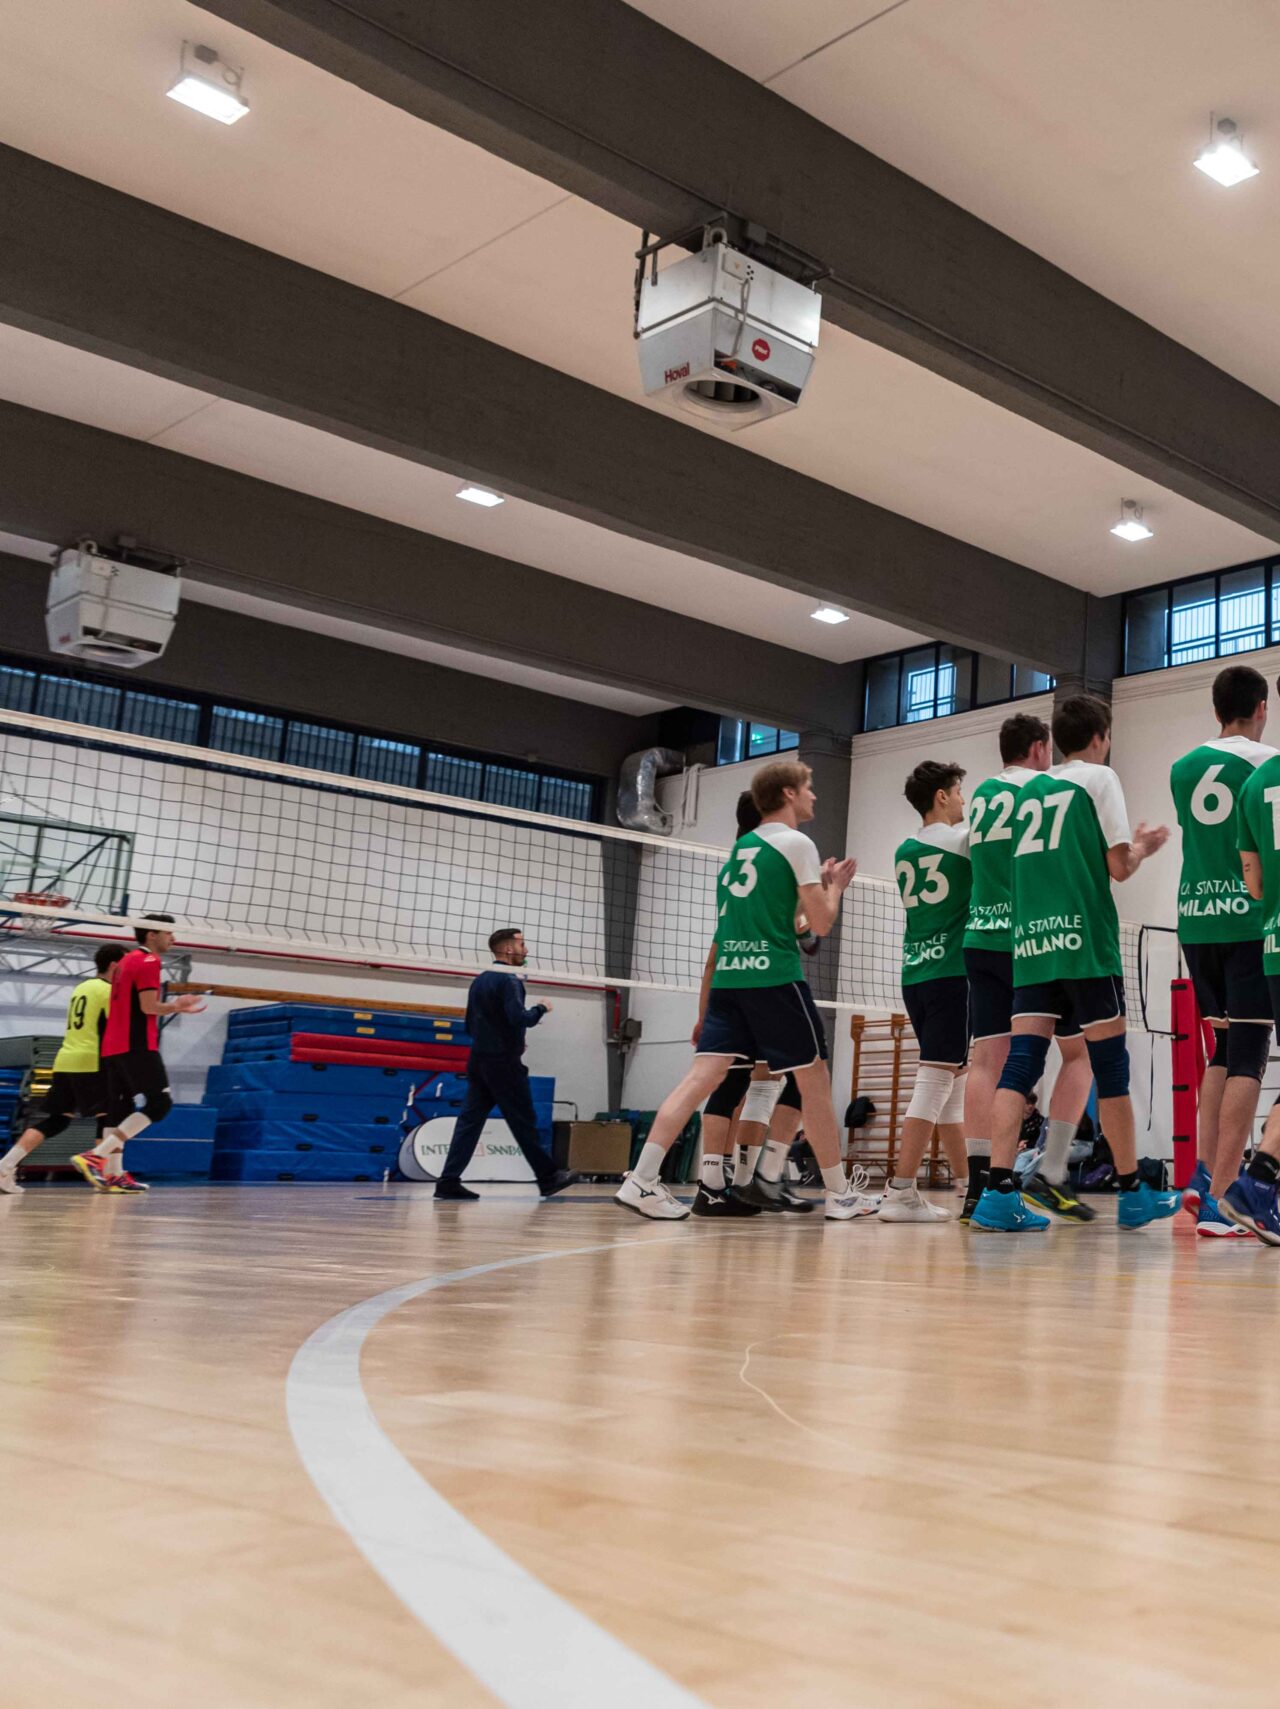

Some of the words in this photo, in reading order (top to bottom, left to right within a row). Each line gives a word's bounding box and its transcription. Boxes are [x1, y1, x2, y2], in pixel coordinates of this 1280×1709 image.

[664, 362, 690, 384] Hoval
[1190, 764, 1234, 825] 6
[969, 790, 1015, 847] 22
[1014, 789, 1076, 857] 27
[728, 846, 763, 898] 3
[895, 853, 950, 909] 23
[1195, 879, 1249, 895] STATALE
[980, 901, 1012, 916] STATA
[1179, 897, 1250, 917] MILANO
[1028, 915, 1083, 934] STATALE
[722, 940, 770, 952] STATALE
[1014, 933, 1083, 960] MILANO
[716, 955, 770, 971] ILANO
[67, 994, 88, 1030] 19
[421, 1143, 450, 1156] INTE
[486, 1143, 522, 1156] SANPA
